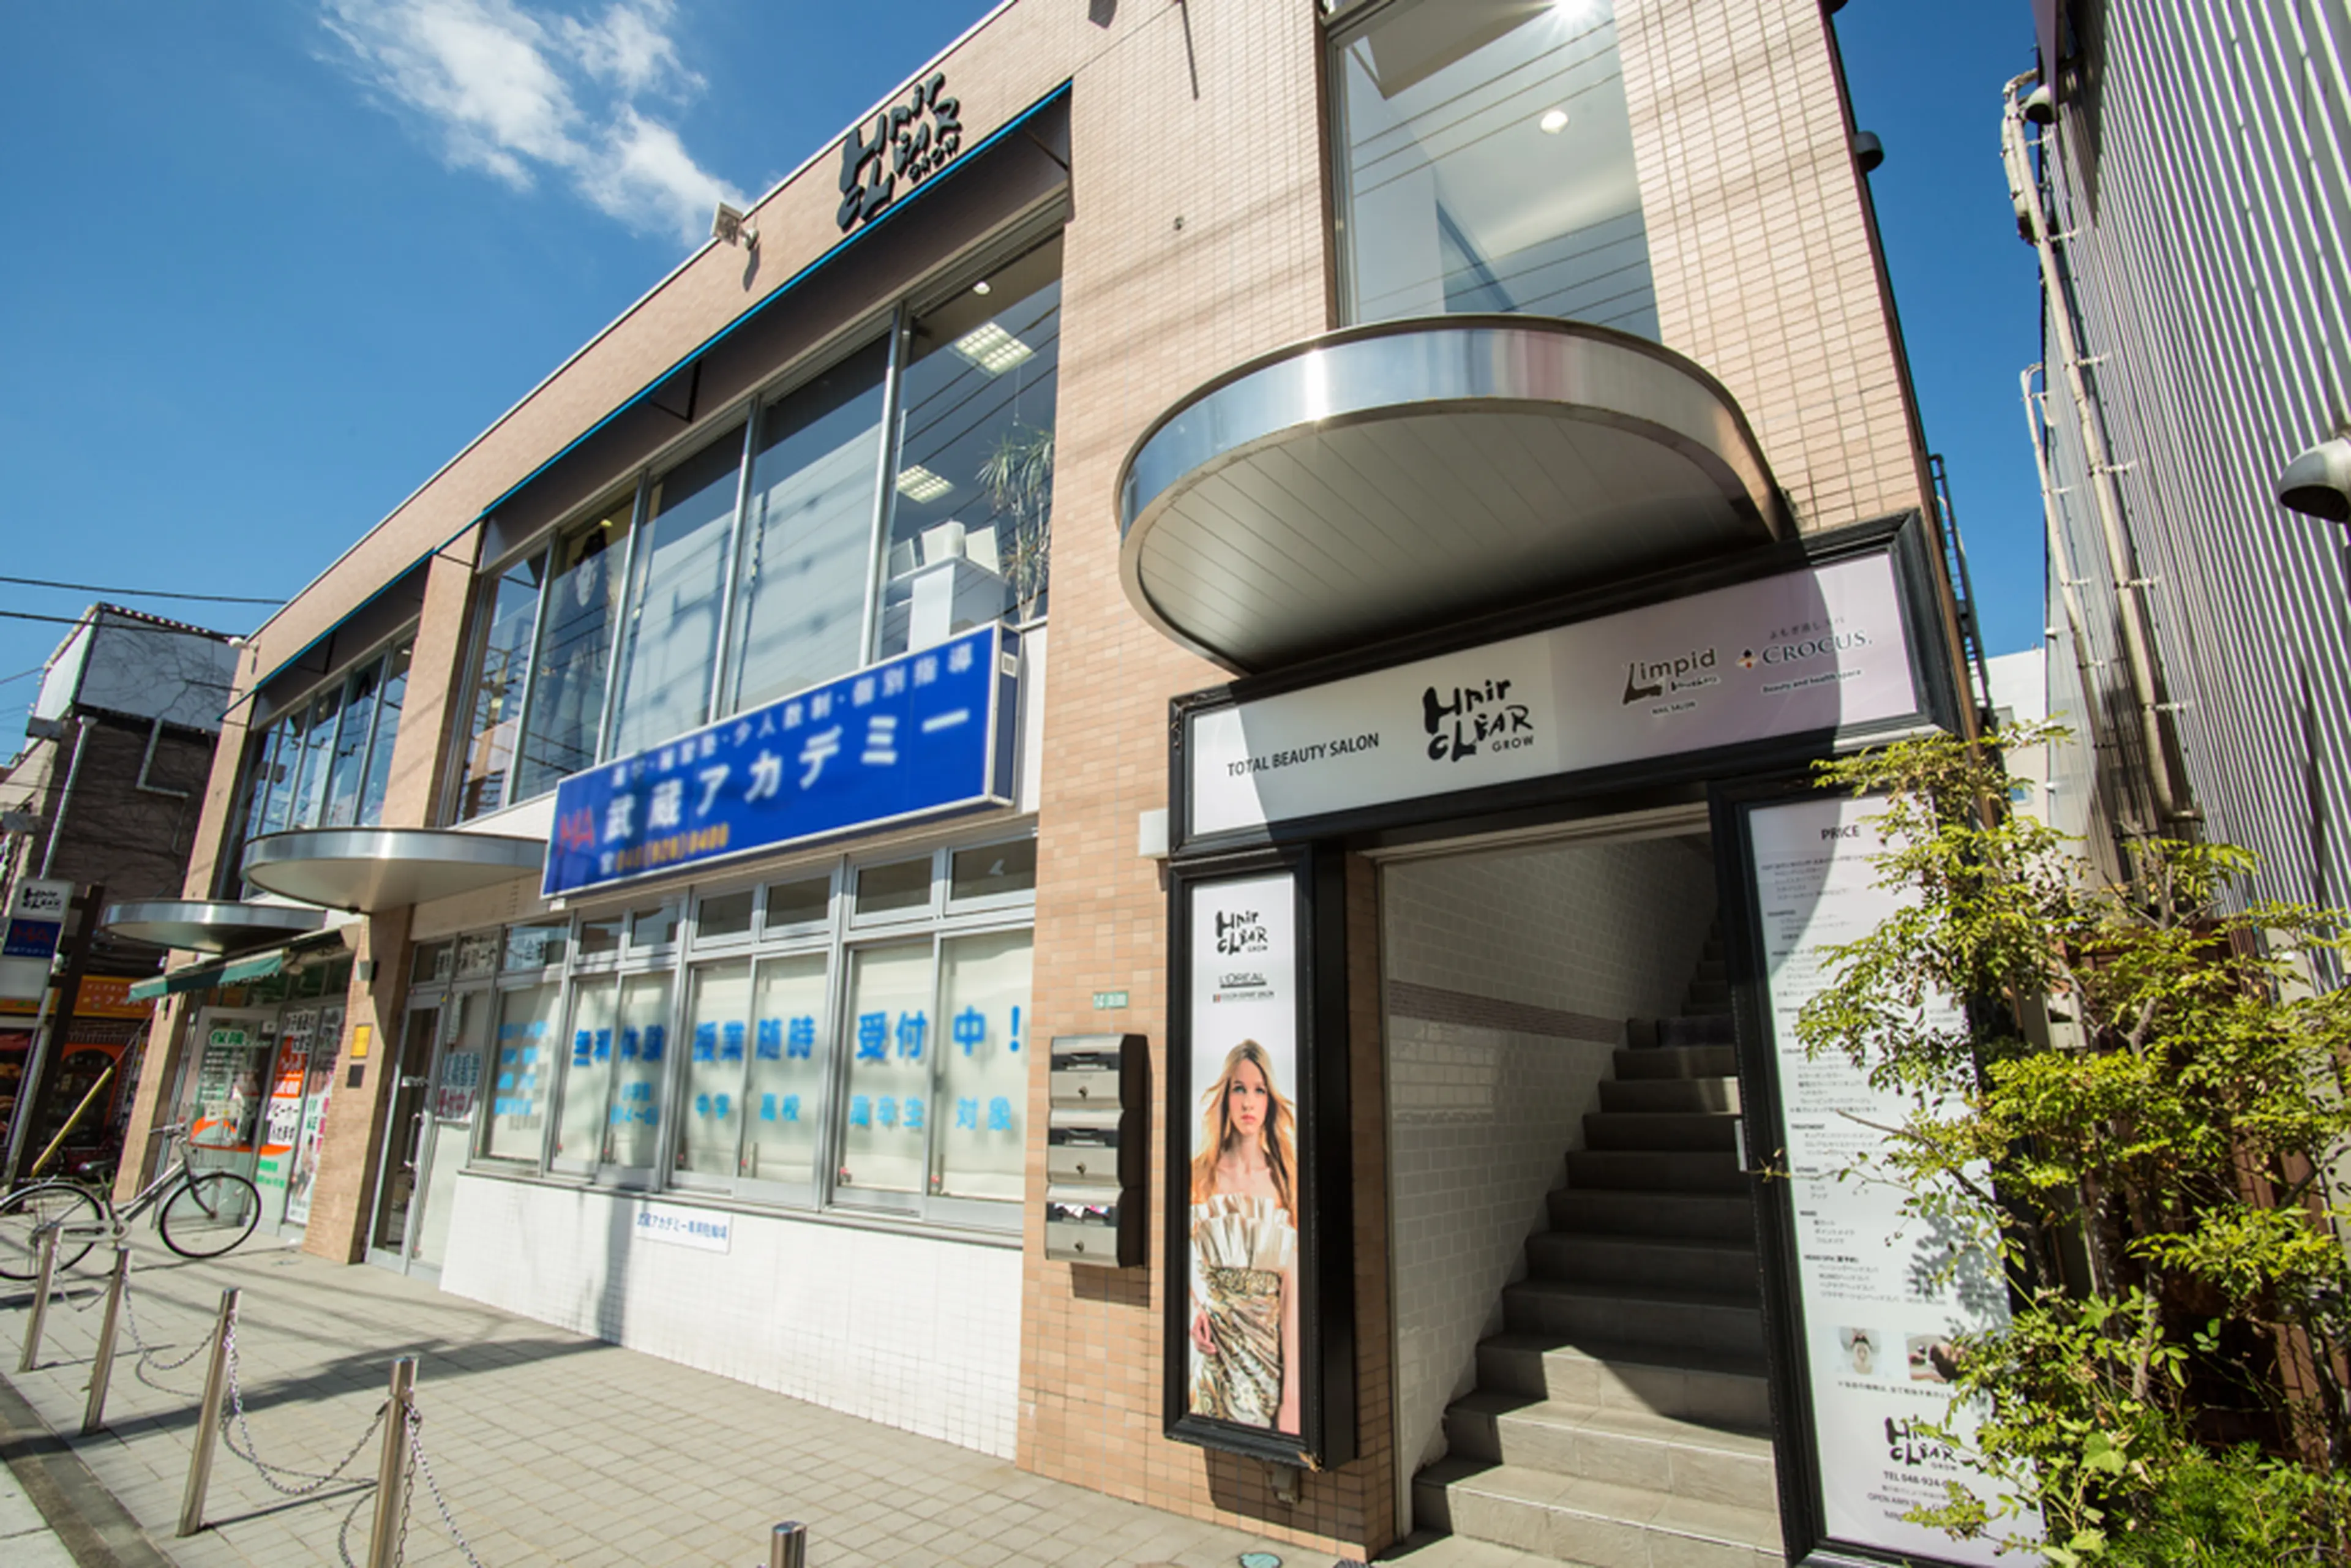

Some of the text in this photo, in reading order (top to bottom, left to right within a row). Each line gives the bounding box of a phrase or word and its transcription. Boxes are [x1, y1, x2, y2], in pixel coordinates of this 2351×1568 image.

[1623, 648, 1716, 705] Limpid
[1226, 732, 1380, 777] TOTAL BEAUTY SALON
[1492, 736, 1534, 752] GROW
[1821, 825, 1860, 841] PRICE
